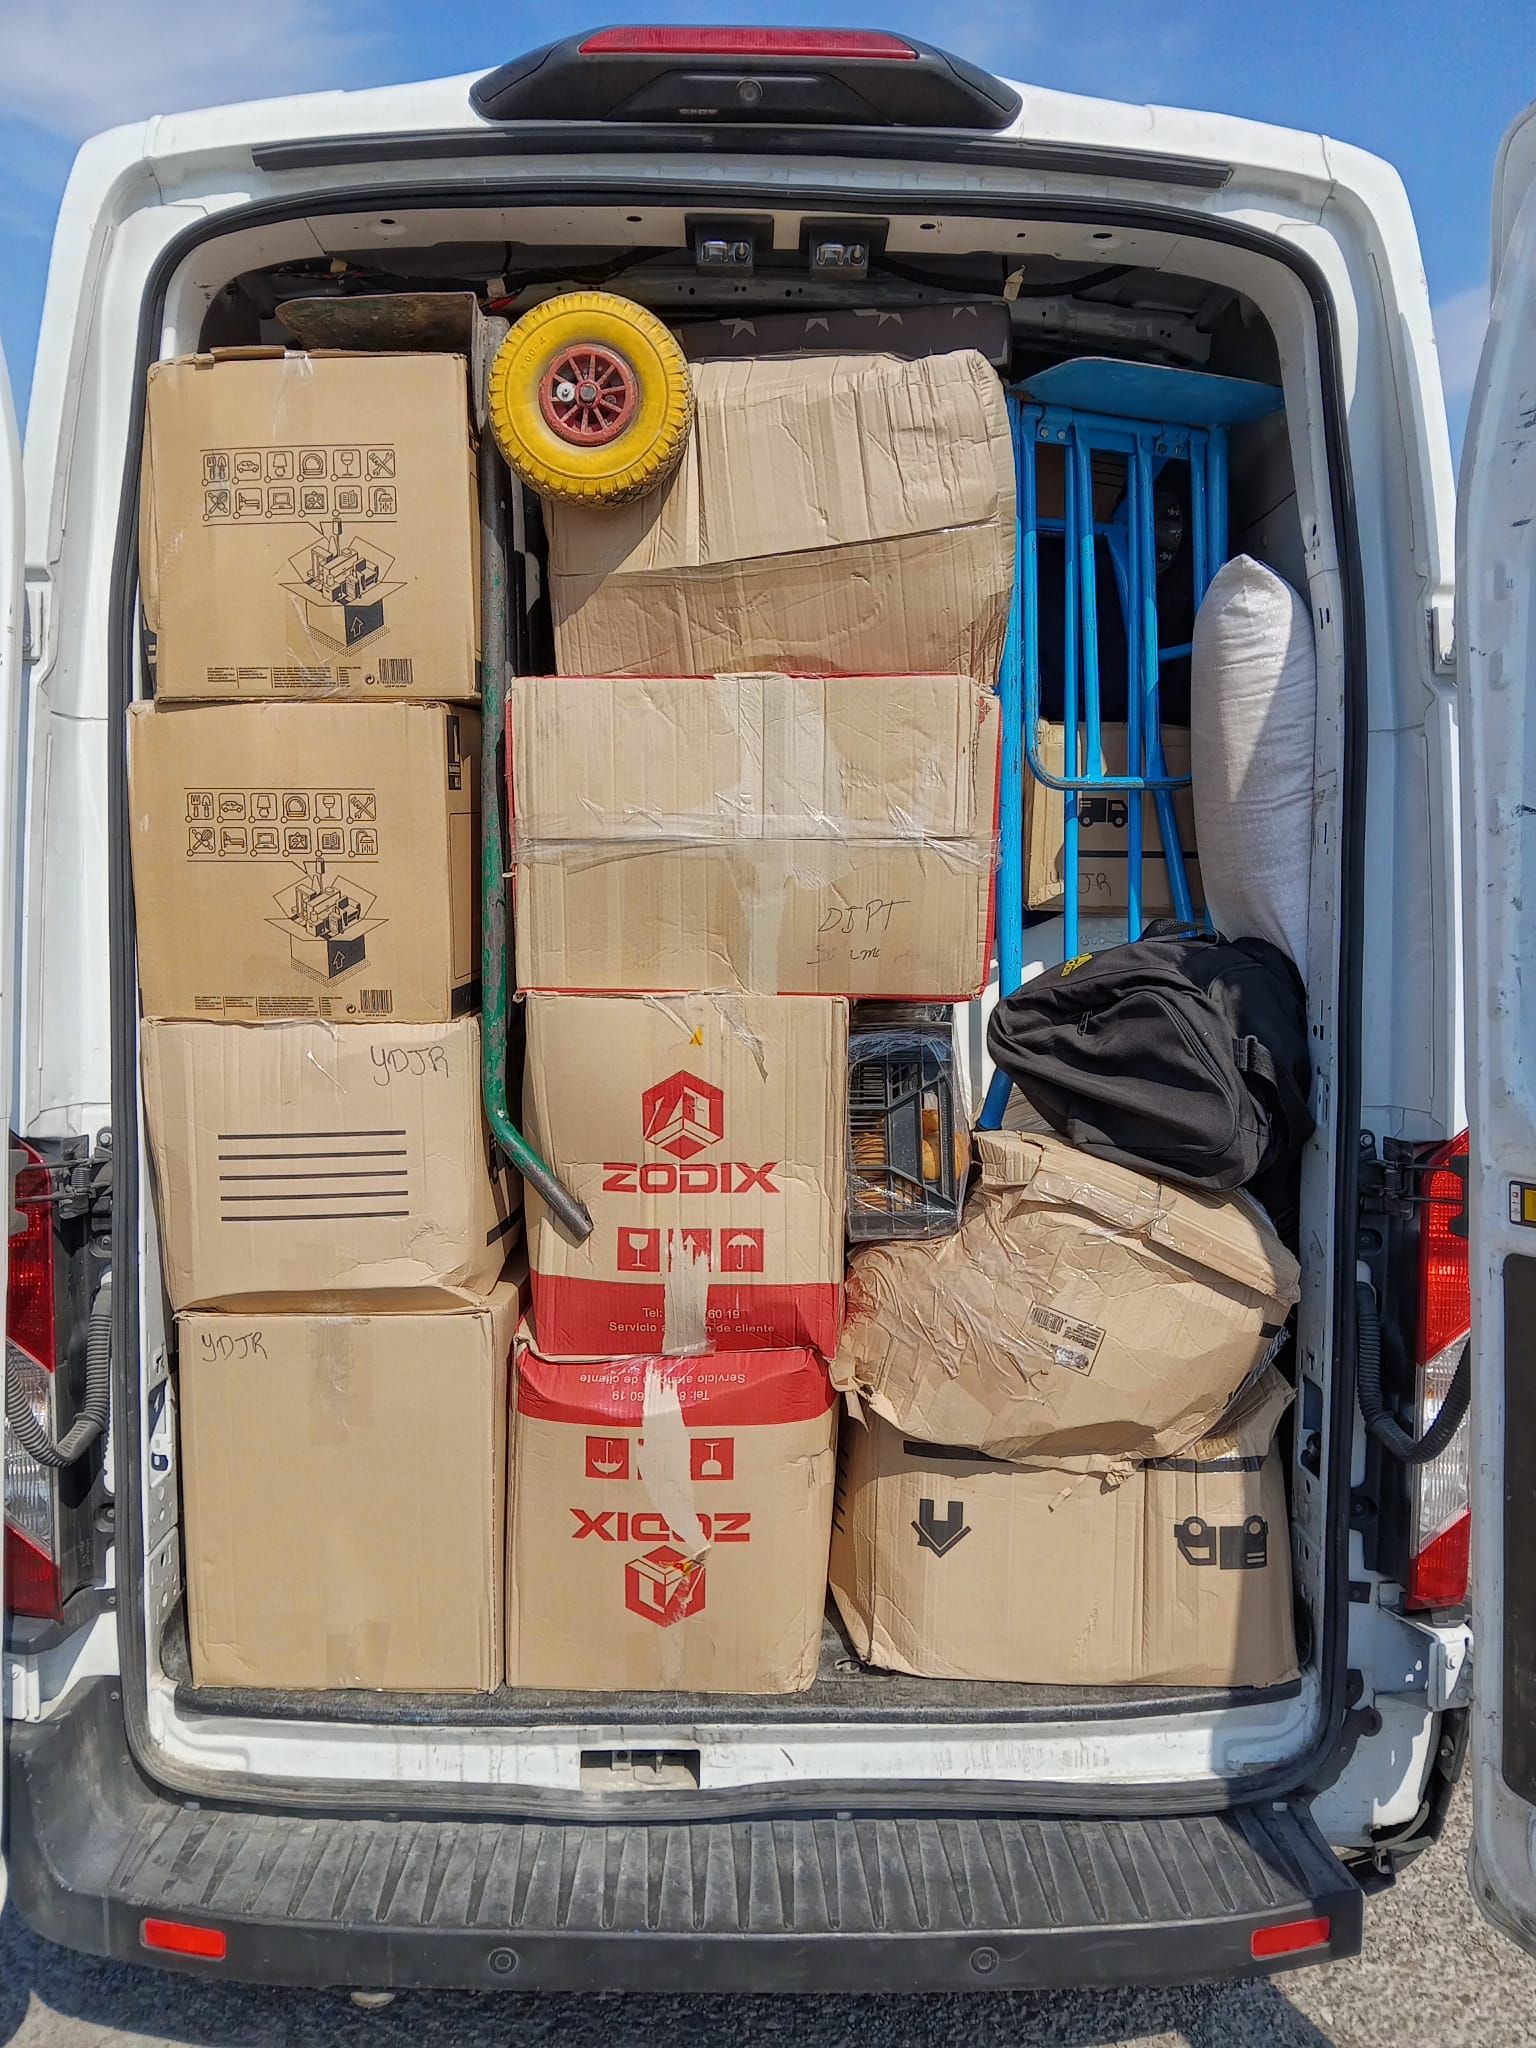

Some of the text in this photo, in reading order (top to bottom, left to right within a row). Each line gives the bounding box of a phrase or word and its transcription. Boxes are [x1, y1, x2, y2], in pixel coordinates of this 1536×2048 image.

[1049, 872, 1112, 896] YJR
[602, 1161, 780, 1194] ZODIX
[642, 1307, 663, 1319] Tel:
[609, 1321, 657, 1333] Servicio
[715, 1322, 731, 1333] de
[735, 1322, 775, 1333] cliente
[579, 1373, 619, 1384] cliente
[623, 1374, 638, 1385] de
[697, 1373, 746, 1384] Servicio
[690, 1389, 709, 1400] Tel:
